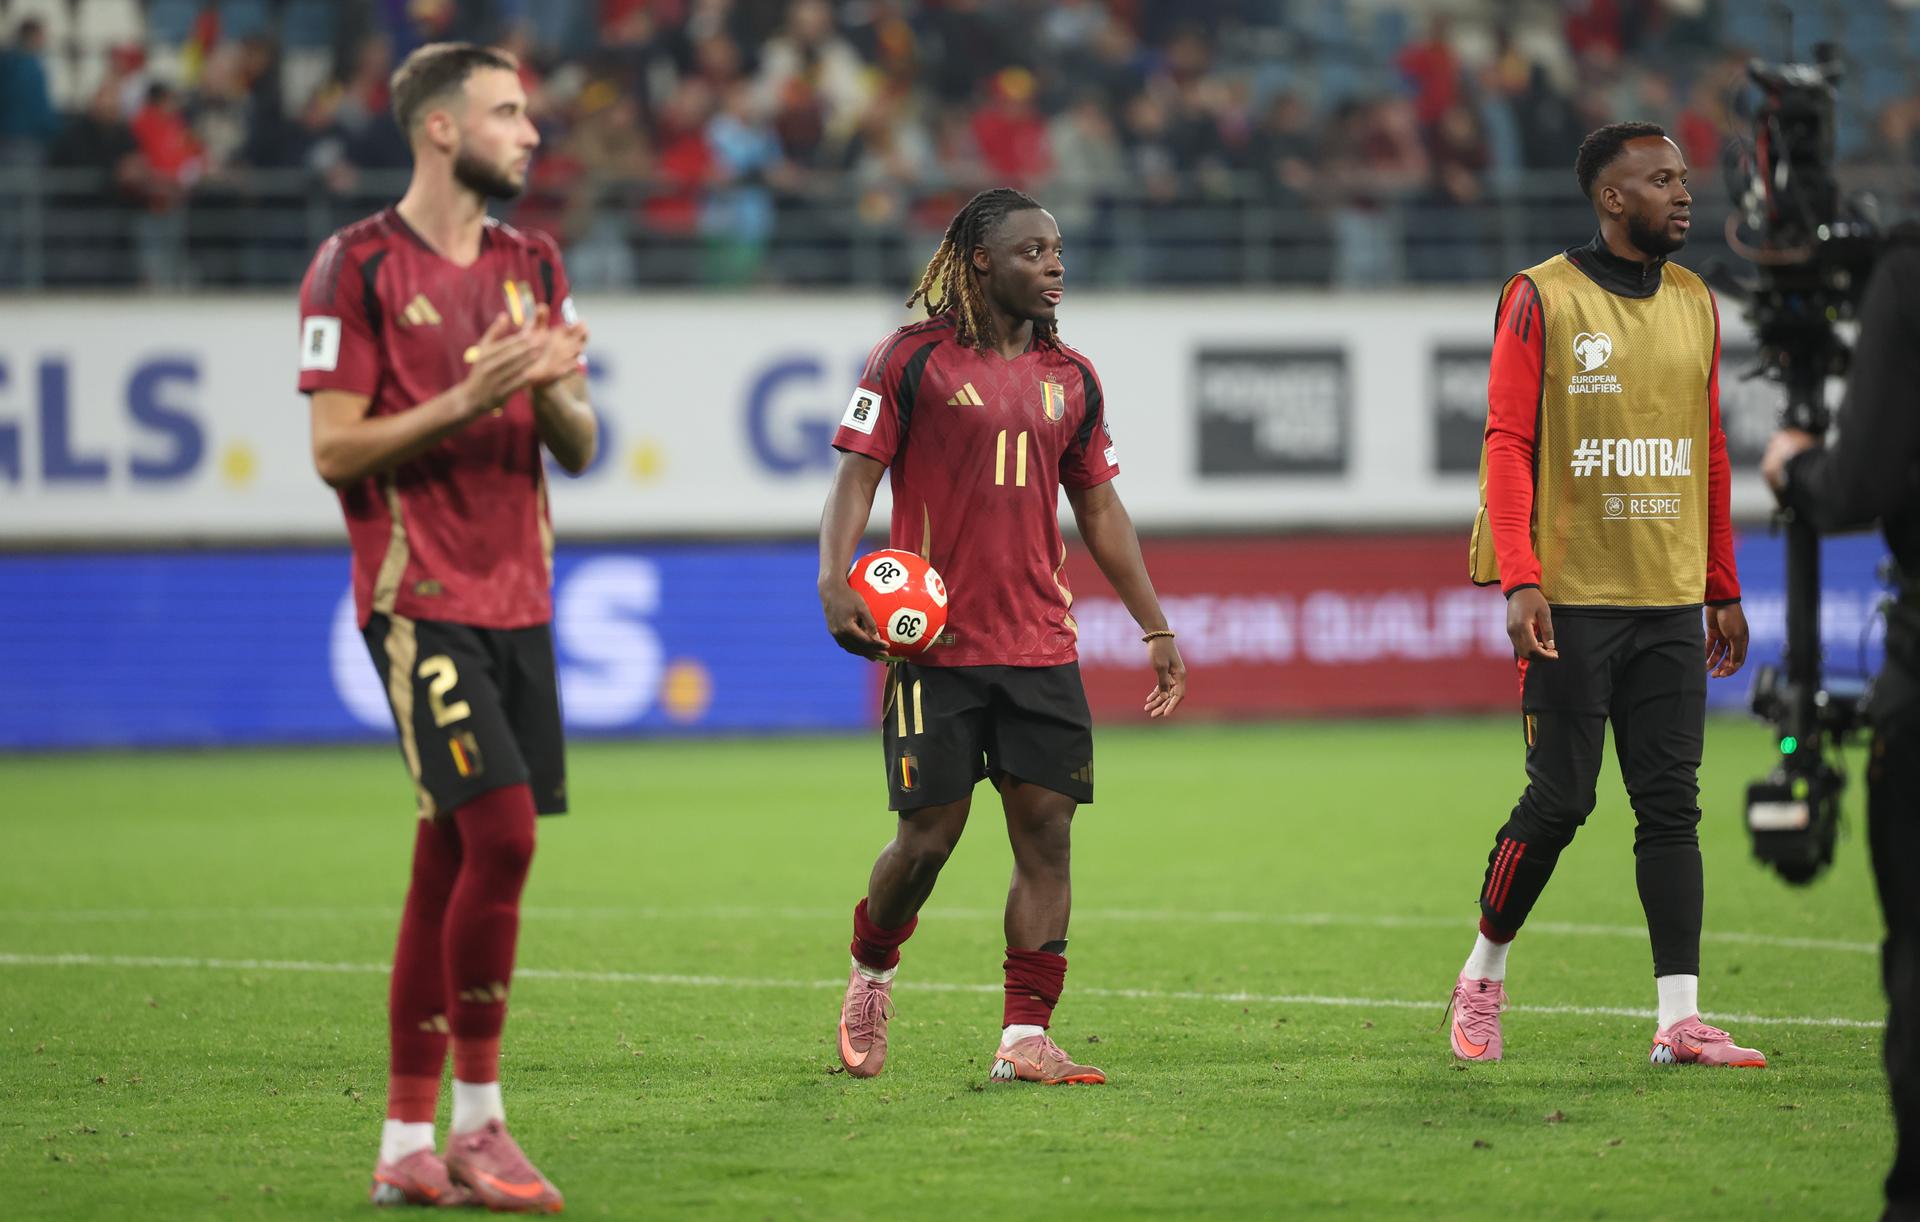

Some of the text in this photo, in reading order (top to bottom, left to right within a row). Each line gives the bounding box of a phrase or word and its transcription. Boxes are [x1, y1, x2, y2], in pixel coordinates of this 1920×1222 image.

[1567, 383, 1623, 395] QUALIFIERS
[1571, 374, 1617, 384] EUROPEAN
[0, 350, 209, 486] LS
[995, 430, 1027, 487] 11
[1570, 438, 1692, 477] #FOOTBALL
[874, 562, 901, 585] 39
[896, 615, 921, 638] 39
[418, 655, 472, 728] 2
[896, 679, 924, 738] 11
